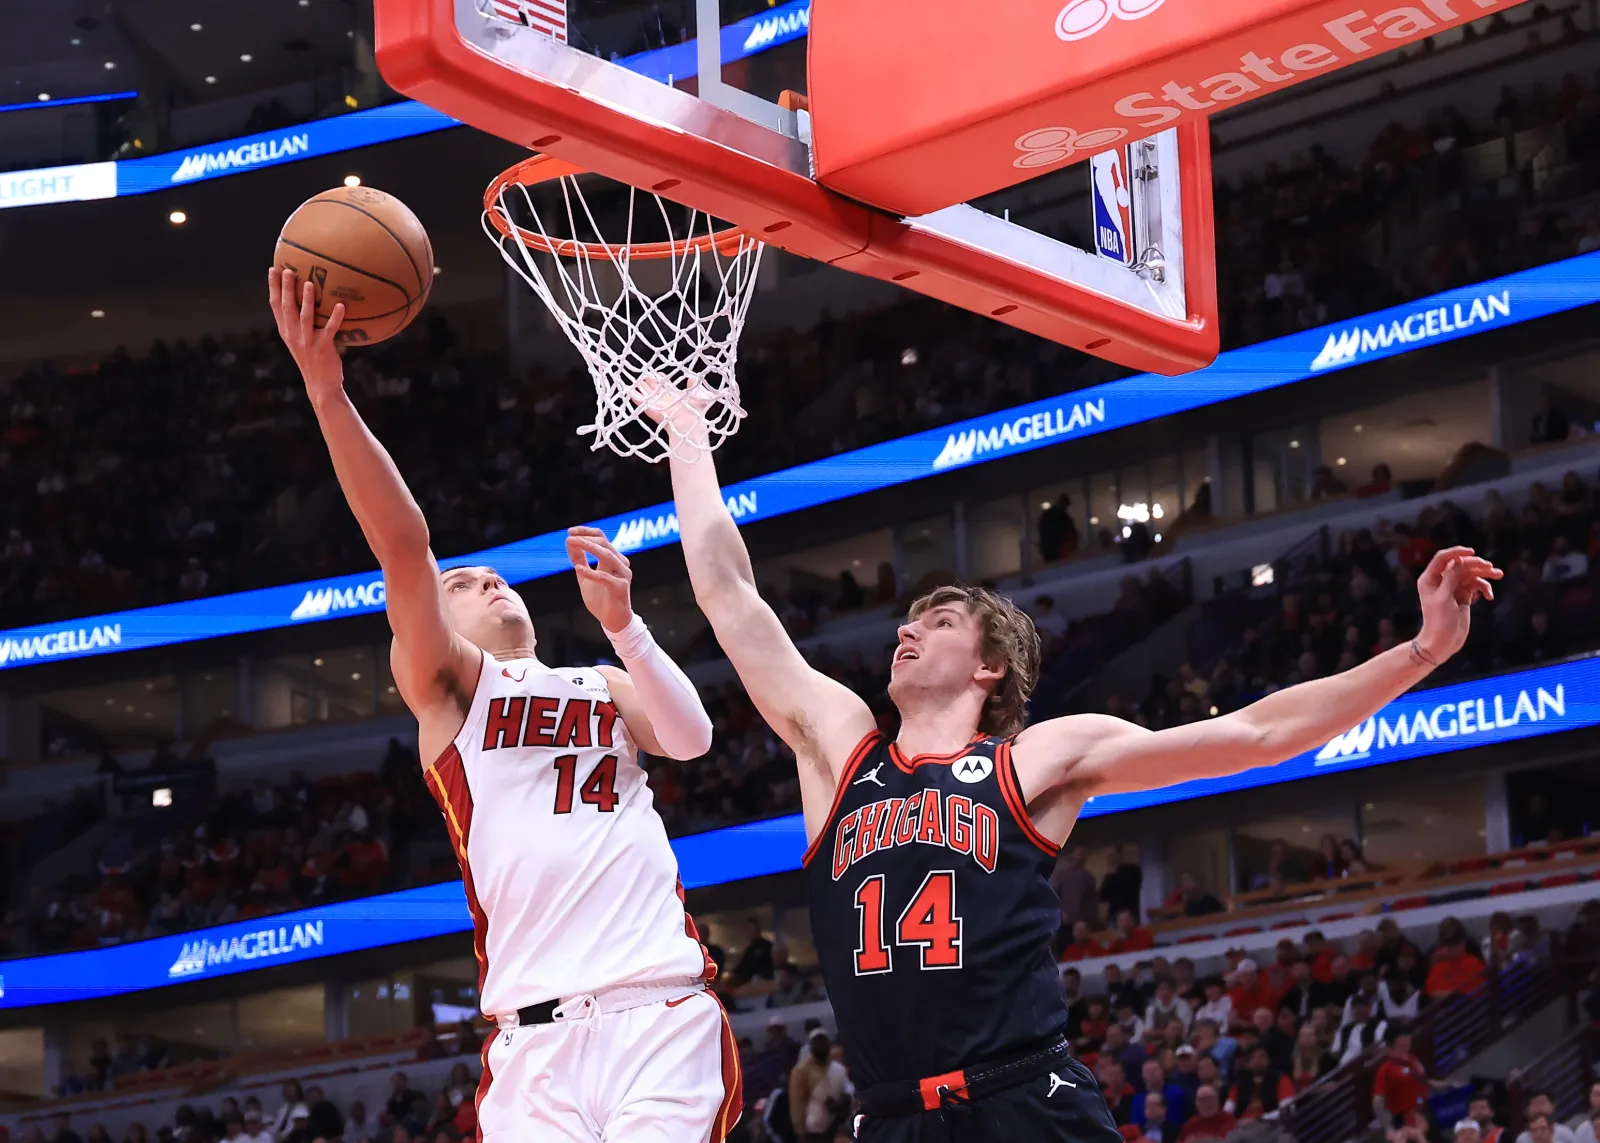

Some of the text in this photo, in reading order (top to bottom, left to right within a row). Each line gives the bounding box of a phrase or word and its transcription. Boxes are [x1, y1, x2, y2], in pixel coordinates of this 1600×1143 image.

[1114, 0, 1498, 128] StateFar
[206, 133, 309, 172] MAGELLAN
[1100, 225, 1120, 254] NBA
[1361, 290, 1510, 354] MAGELLAN
[976, 397, 1105, 455] MAGELLAN
[9, 623, 121, 661] MAGELLAN
[482, 695, 621, 752] HEAT
[1377, 683, 1566, 750] MAGELLAN
[553, 754, 619, 815] 14
[832, 788, 999, 881] CHICAGO
[207, 920, 323, 967] MAGELLAN
[854, 870, 963, 976] 14
